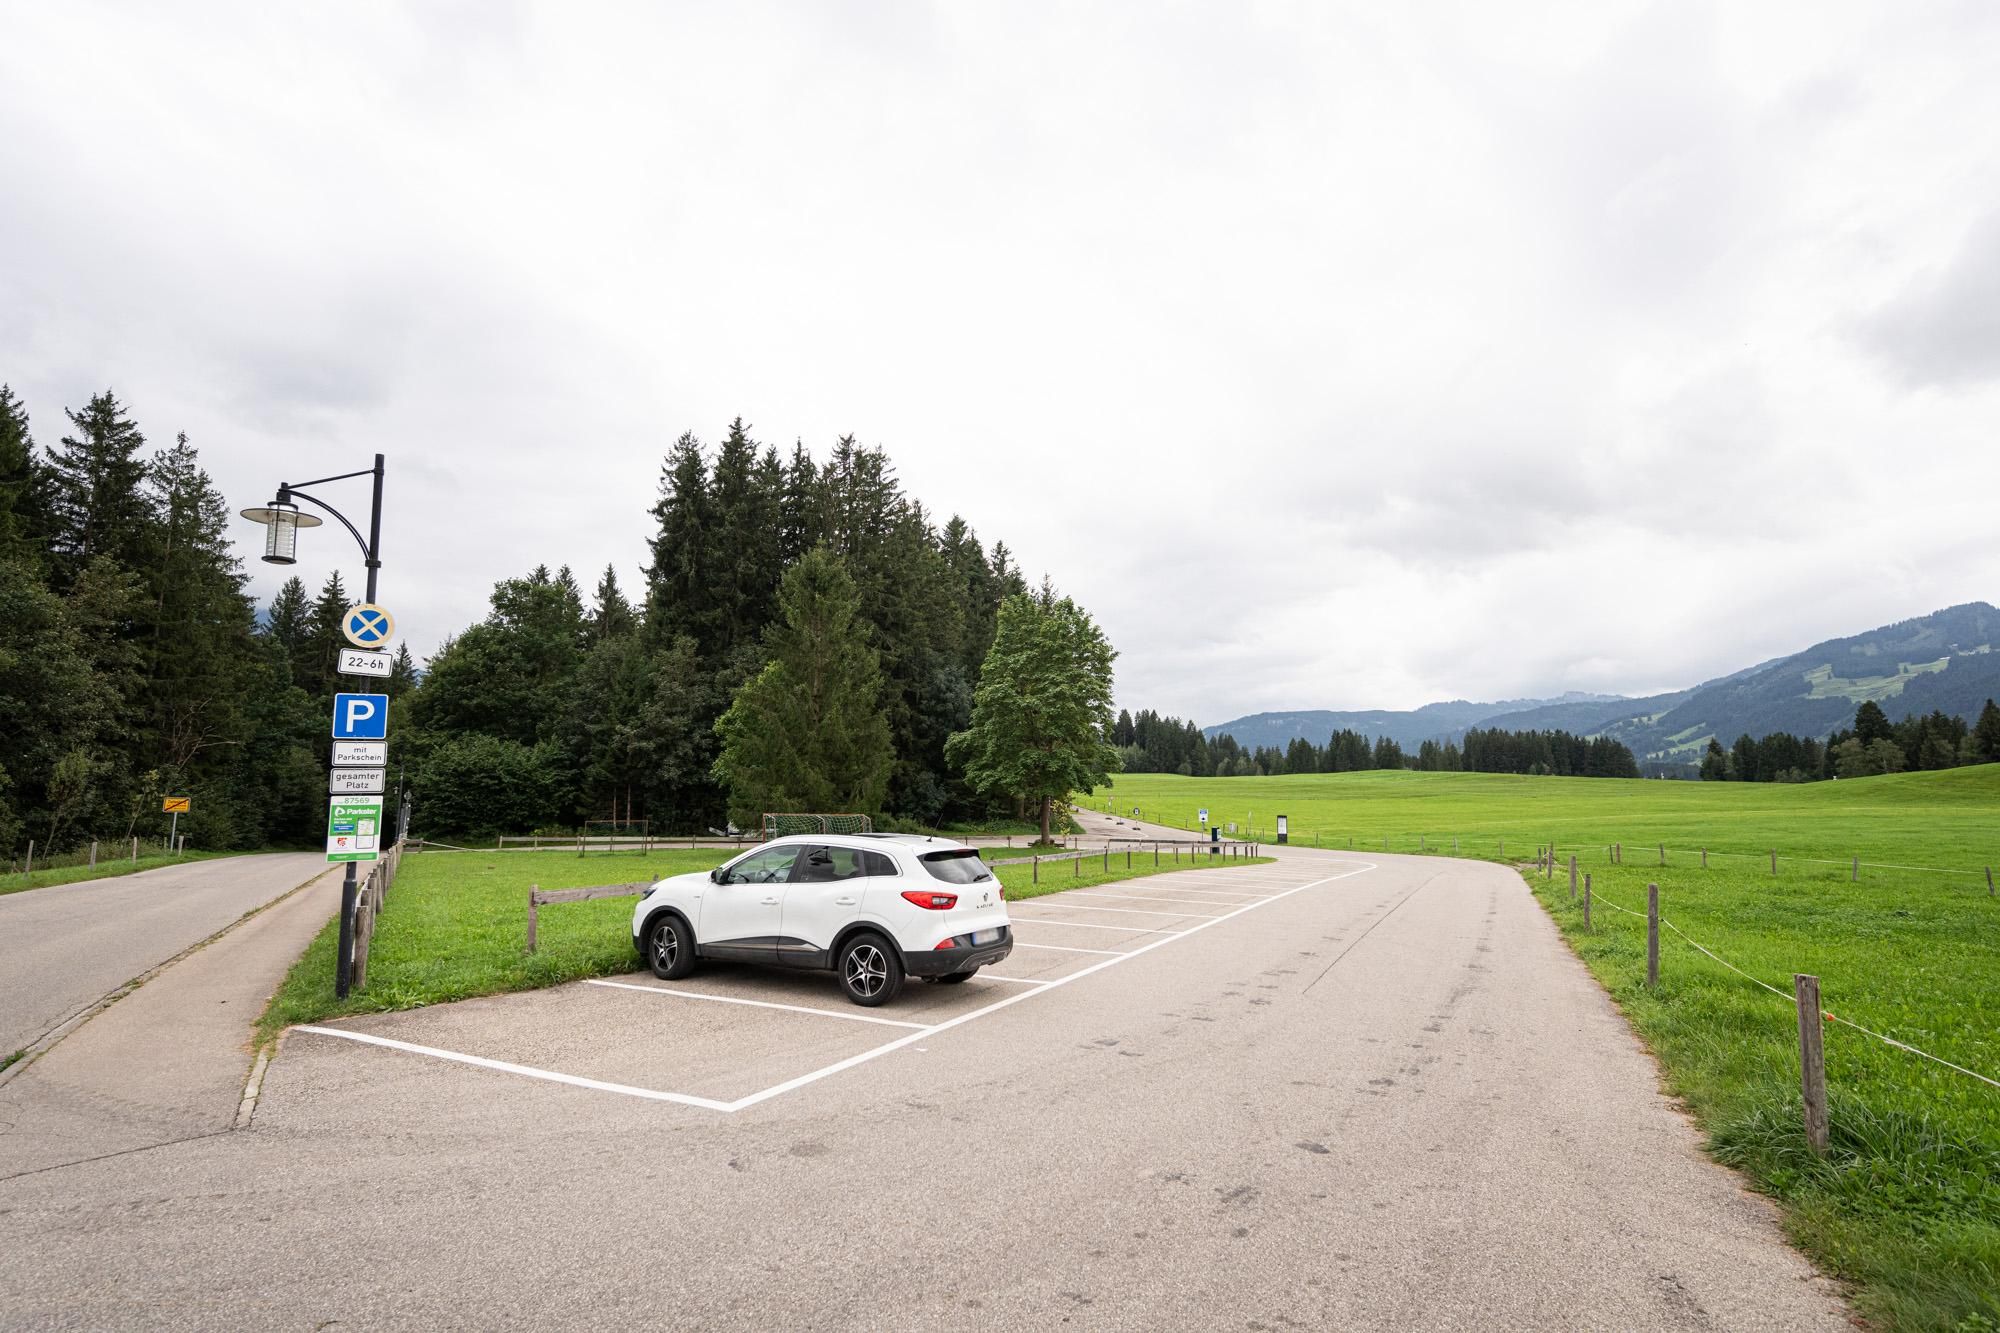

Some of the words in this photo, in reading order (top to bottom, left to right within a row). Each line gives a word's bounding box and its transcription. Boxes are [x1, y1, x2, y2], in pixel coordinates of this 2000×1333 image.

[348, 657, 383, 669] 22-6h
[346, 700, 375, 732] P
[336, 773, 379, 782] gesamter
[346, 781, 369, 789] Platz
